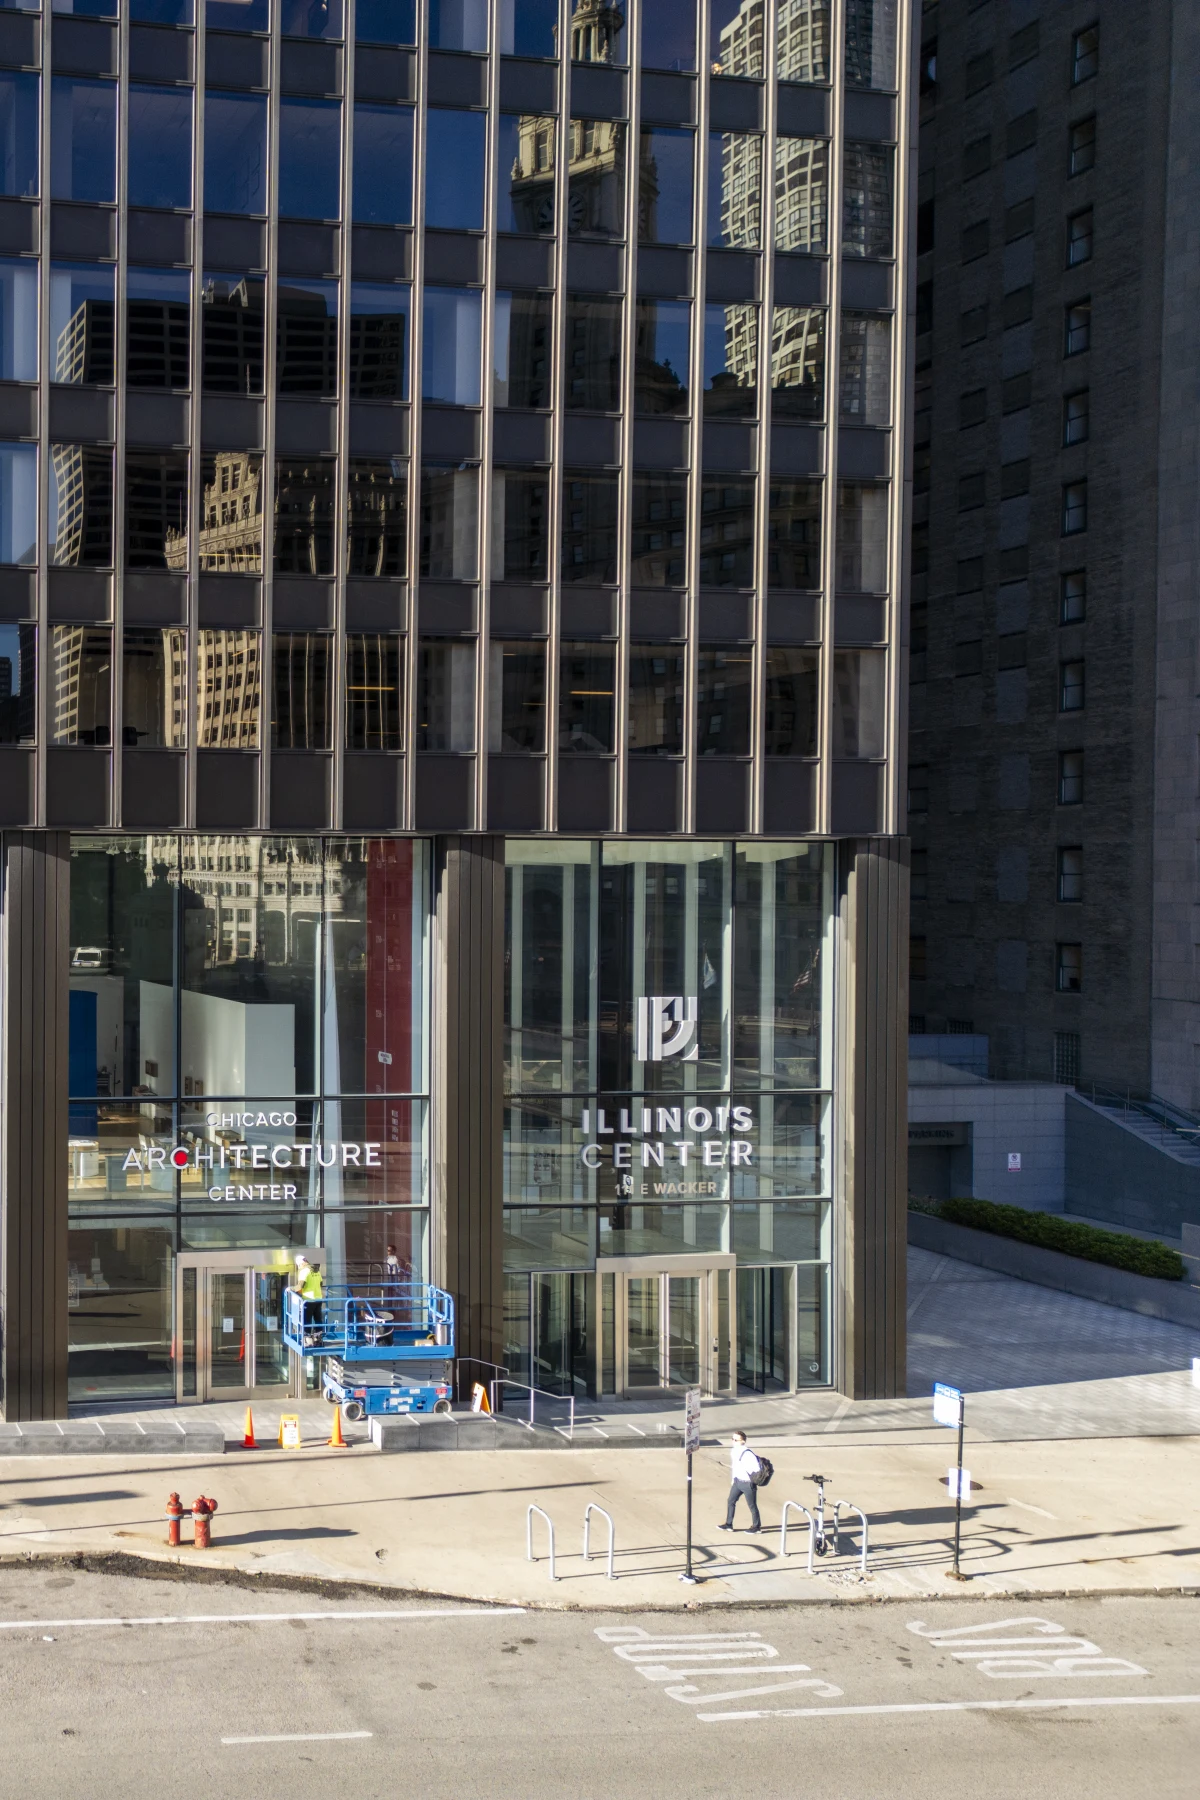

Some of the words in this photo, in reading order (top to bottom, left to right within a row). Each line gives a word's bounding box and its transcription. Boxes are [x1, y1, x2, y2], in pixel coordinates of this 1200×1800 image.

[206, 1111, 297, 1128] CHICAGO
[581, 1106, 753, 1134] ILLINOIS
[122, 1142, 382, 1171] ARCHITECTURE
[580, 1139, 753, 1169] CENTER
[208, 1184, 298, 1201] CENTER
[640, 1183, 649, 1195] E
[653, 1181, 717, 1195] WACKER
[906, 1616, 1154, 1679] BUS
[593, 1624, 845, 1704] STOP
